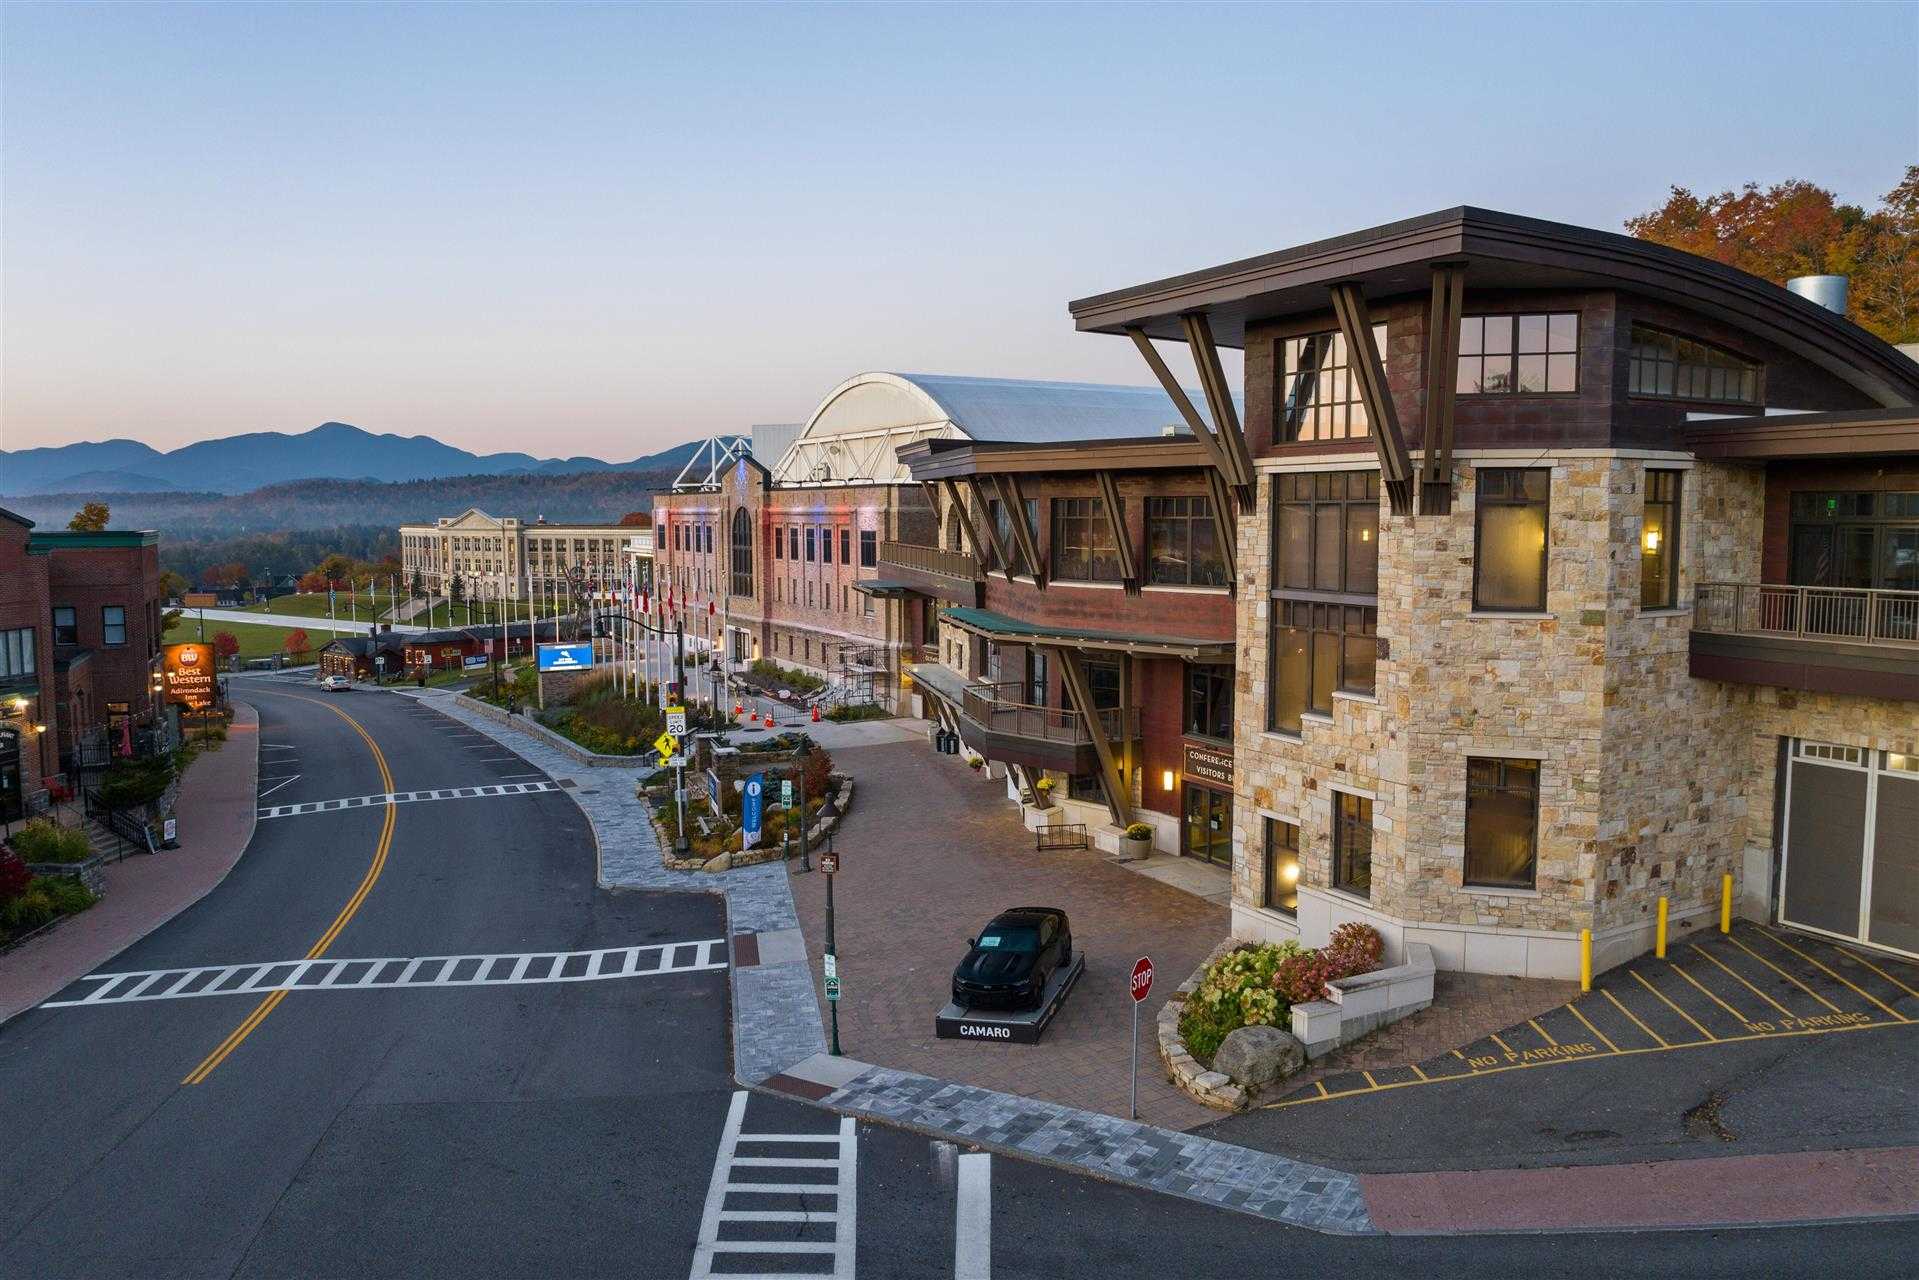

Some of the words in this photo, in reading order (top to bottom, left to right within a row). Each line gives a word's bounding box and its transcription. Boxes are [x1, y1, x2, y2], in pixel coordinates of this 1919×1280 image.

[179, 668, 201, 676] Best
[169, 676, 211, 685] Western
[171, 686, 211, 695] Adirondack
[669, 725, 684, 734] 20
[1196, 765, 1225, 780] VISITORS
[1132, 968, 1152, 991] STOP
[1743, 1022, 1776, 1033] NO
[1779, 1012, 1871, 1030] PARKING
[960, 1025, 1011, 1038] CAMARO
[1467, 1056, 1498, 1068] NO
[1504, 1043, 1596, 1062] PARKING
